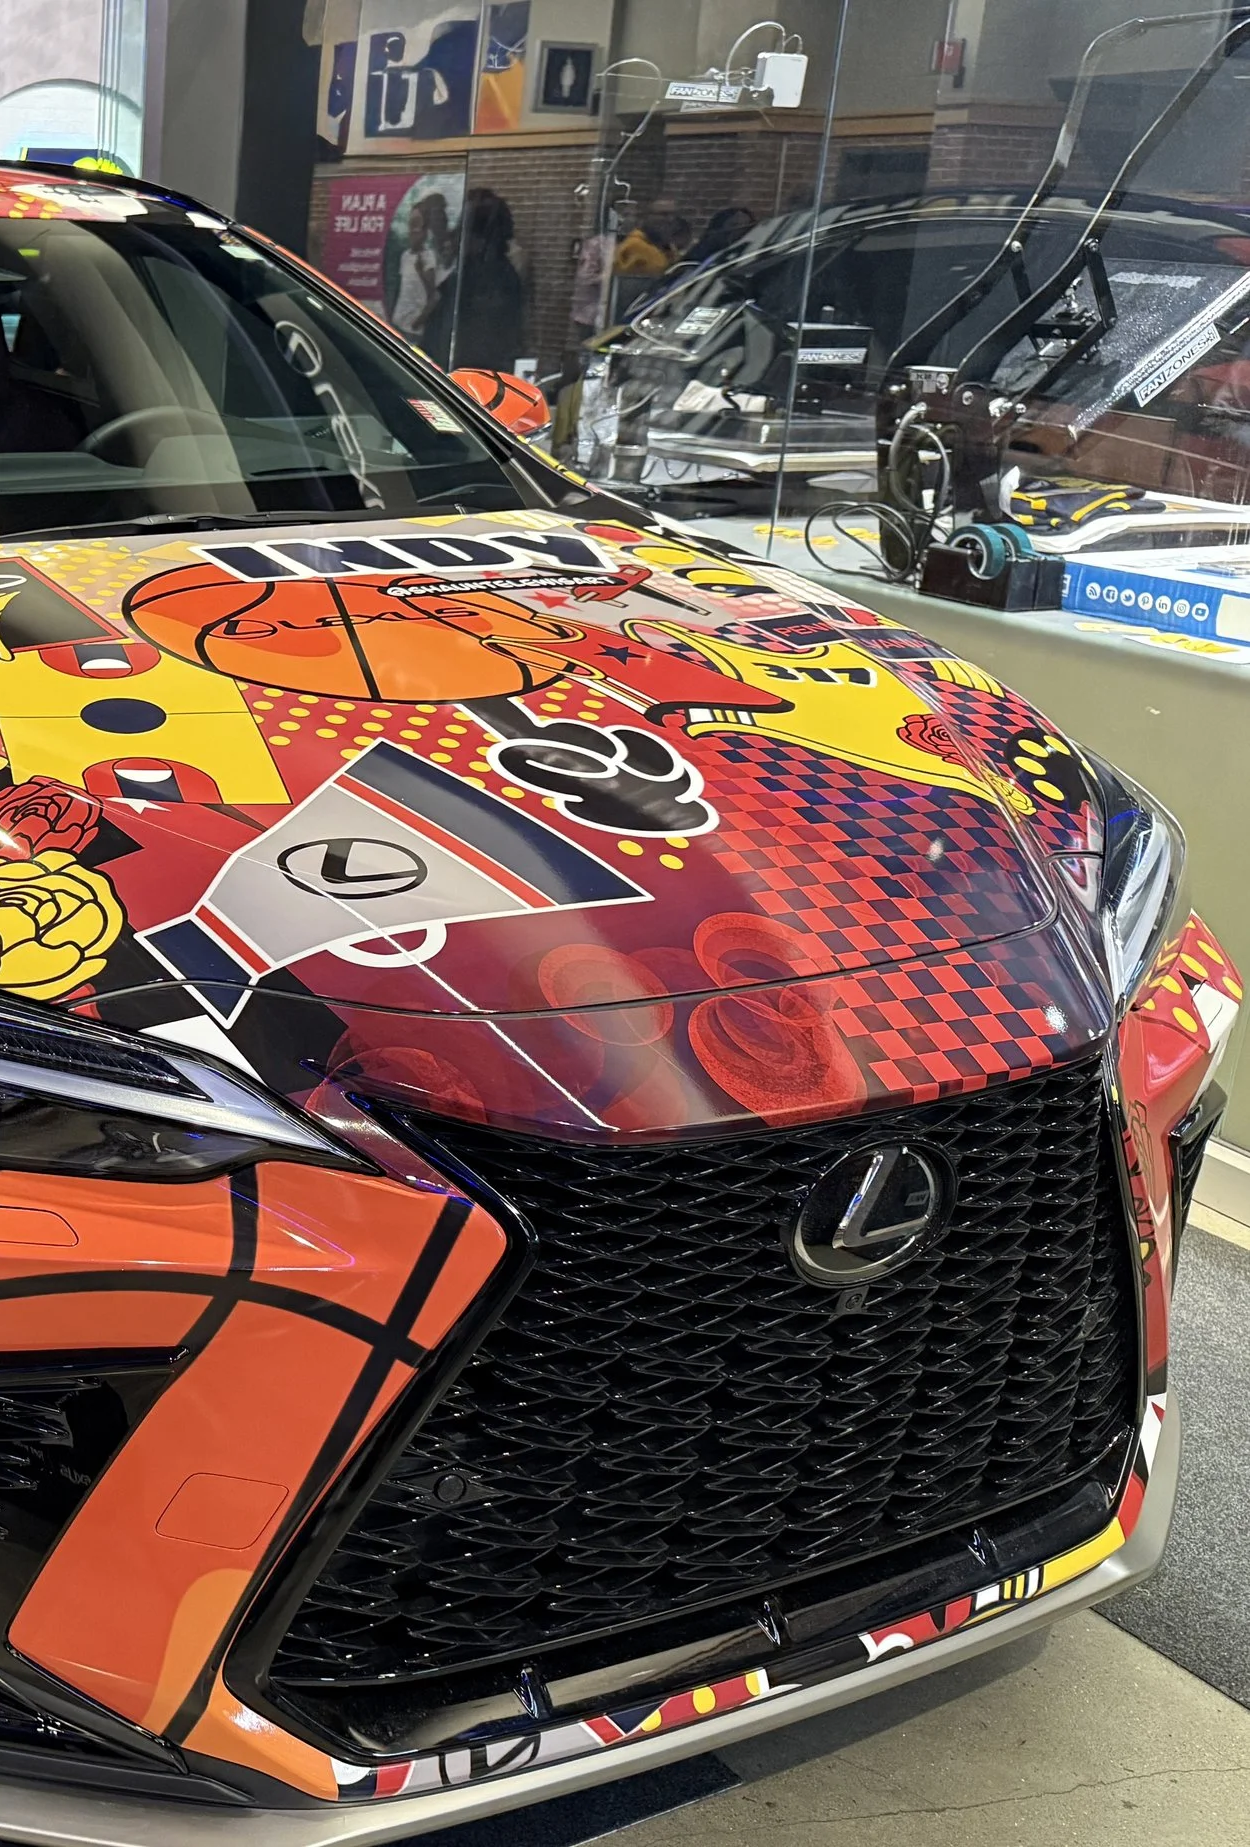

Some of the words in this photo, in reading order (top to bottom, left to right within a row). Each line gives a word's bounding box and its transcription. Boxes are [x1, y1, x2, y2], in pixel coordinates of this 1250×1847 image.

[186, 532, 620, 582] INDY
[386, 575, 619, 598] @SHAUNTELEWISART
[277, 606, 480, 630] LEXUS
[752, 660, 877, 688] 317
